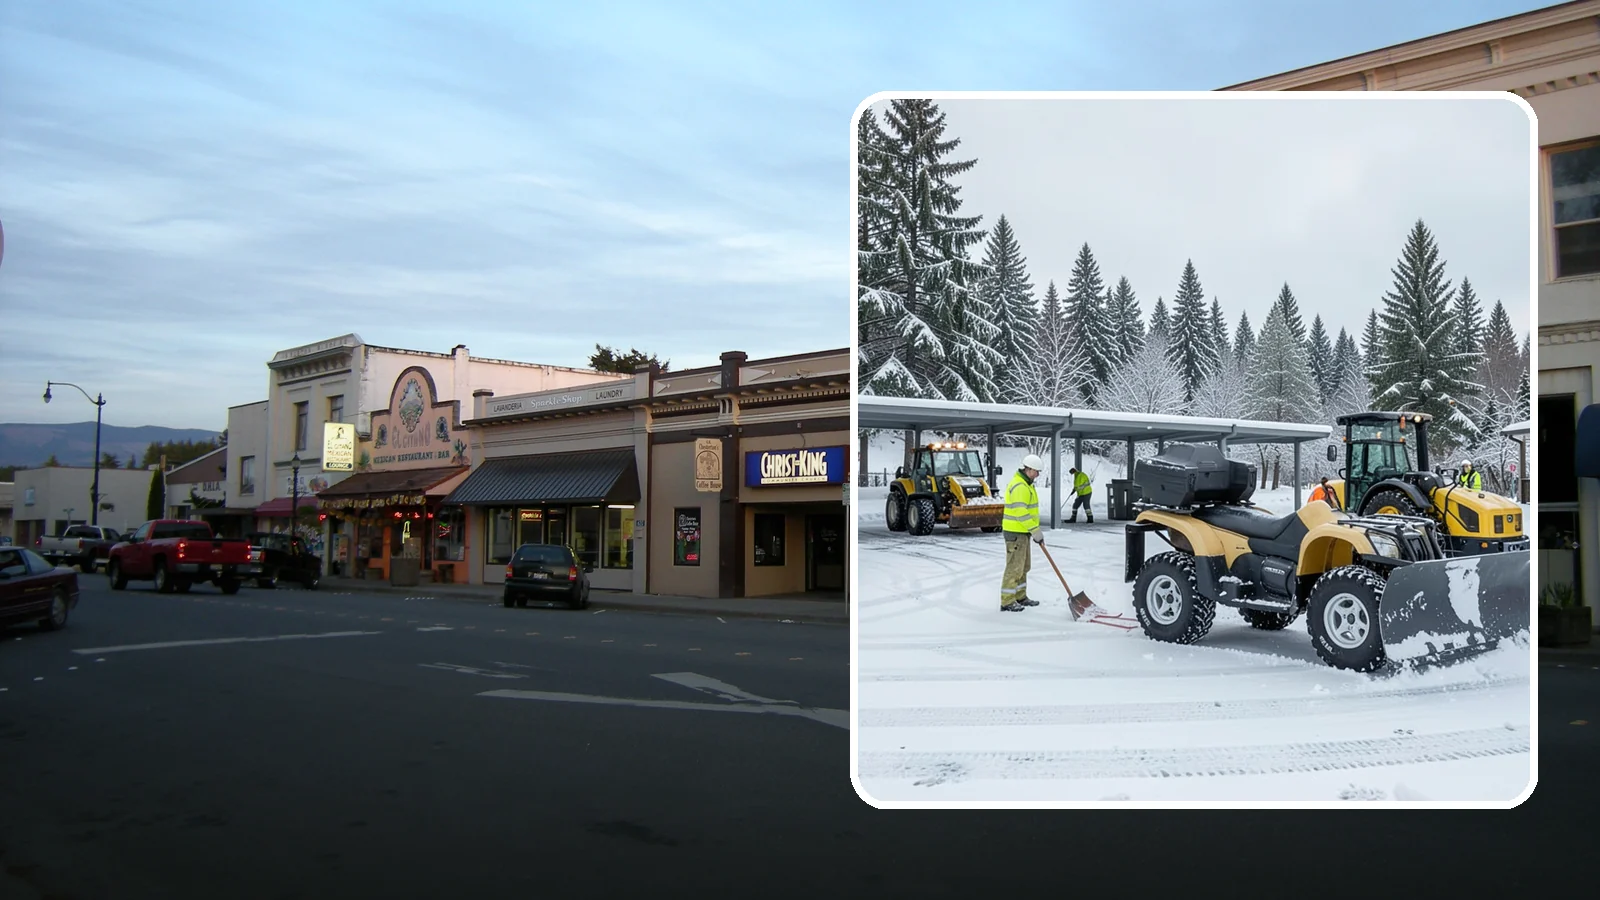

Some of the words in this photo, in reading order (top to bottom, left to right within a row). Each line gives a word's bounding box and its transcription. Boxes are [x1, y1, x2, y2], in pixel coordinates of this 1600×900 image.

[595, 389, 623, 399] LAUNDRY
[493, 402, 522, 413] LAVANDERIA
[531, 398, 560, 409] Sparkle
[562, 394, 582, 406] Shop
[373, 454, 396, 464] MEXICAN
[398, 452, 433, 462] RESTAURANT
[438, 450, 450, 459] BAR
[761, 452, 797, 478] CHRIST
[799, 450, 827, 476] KING
